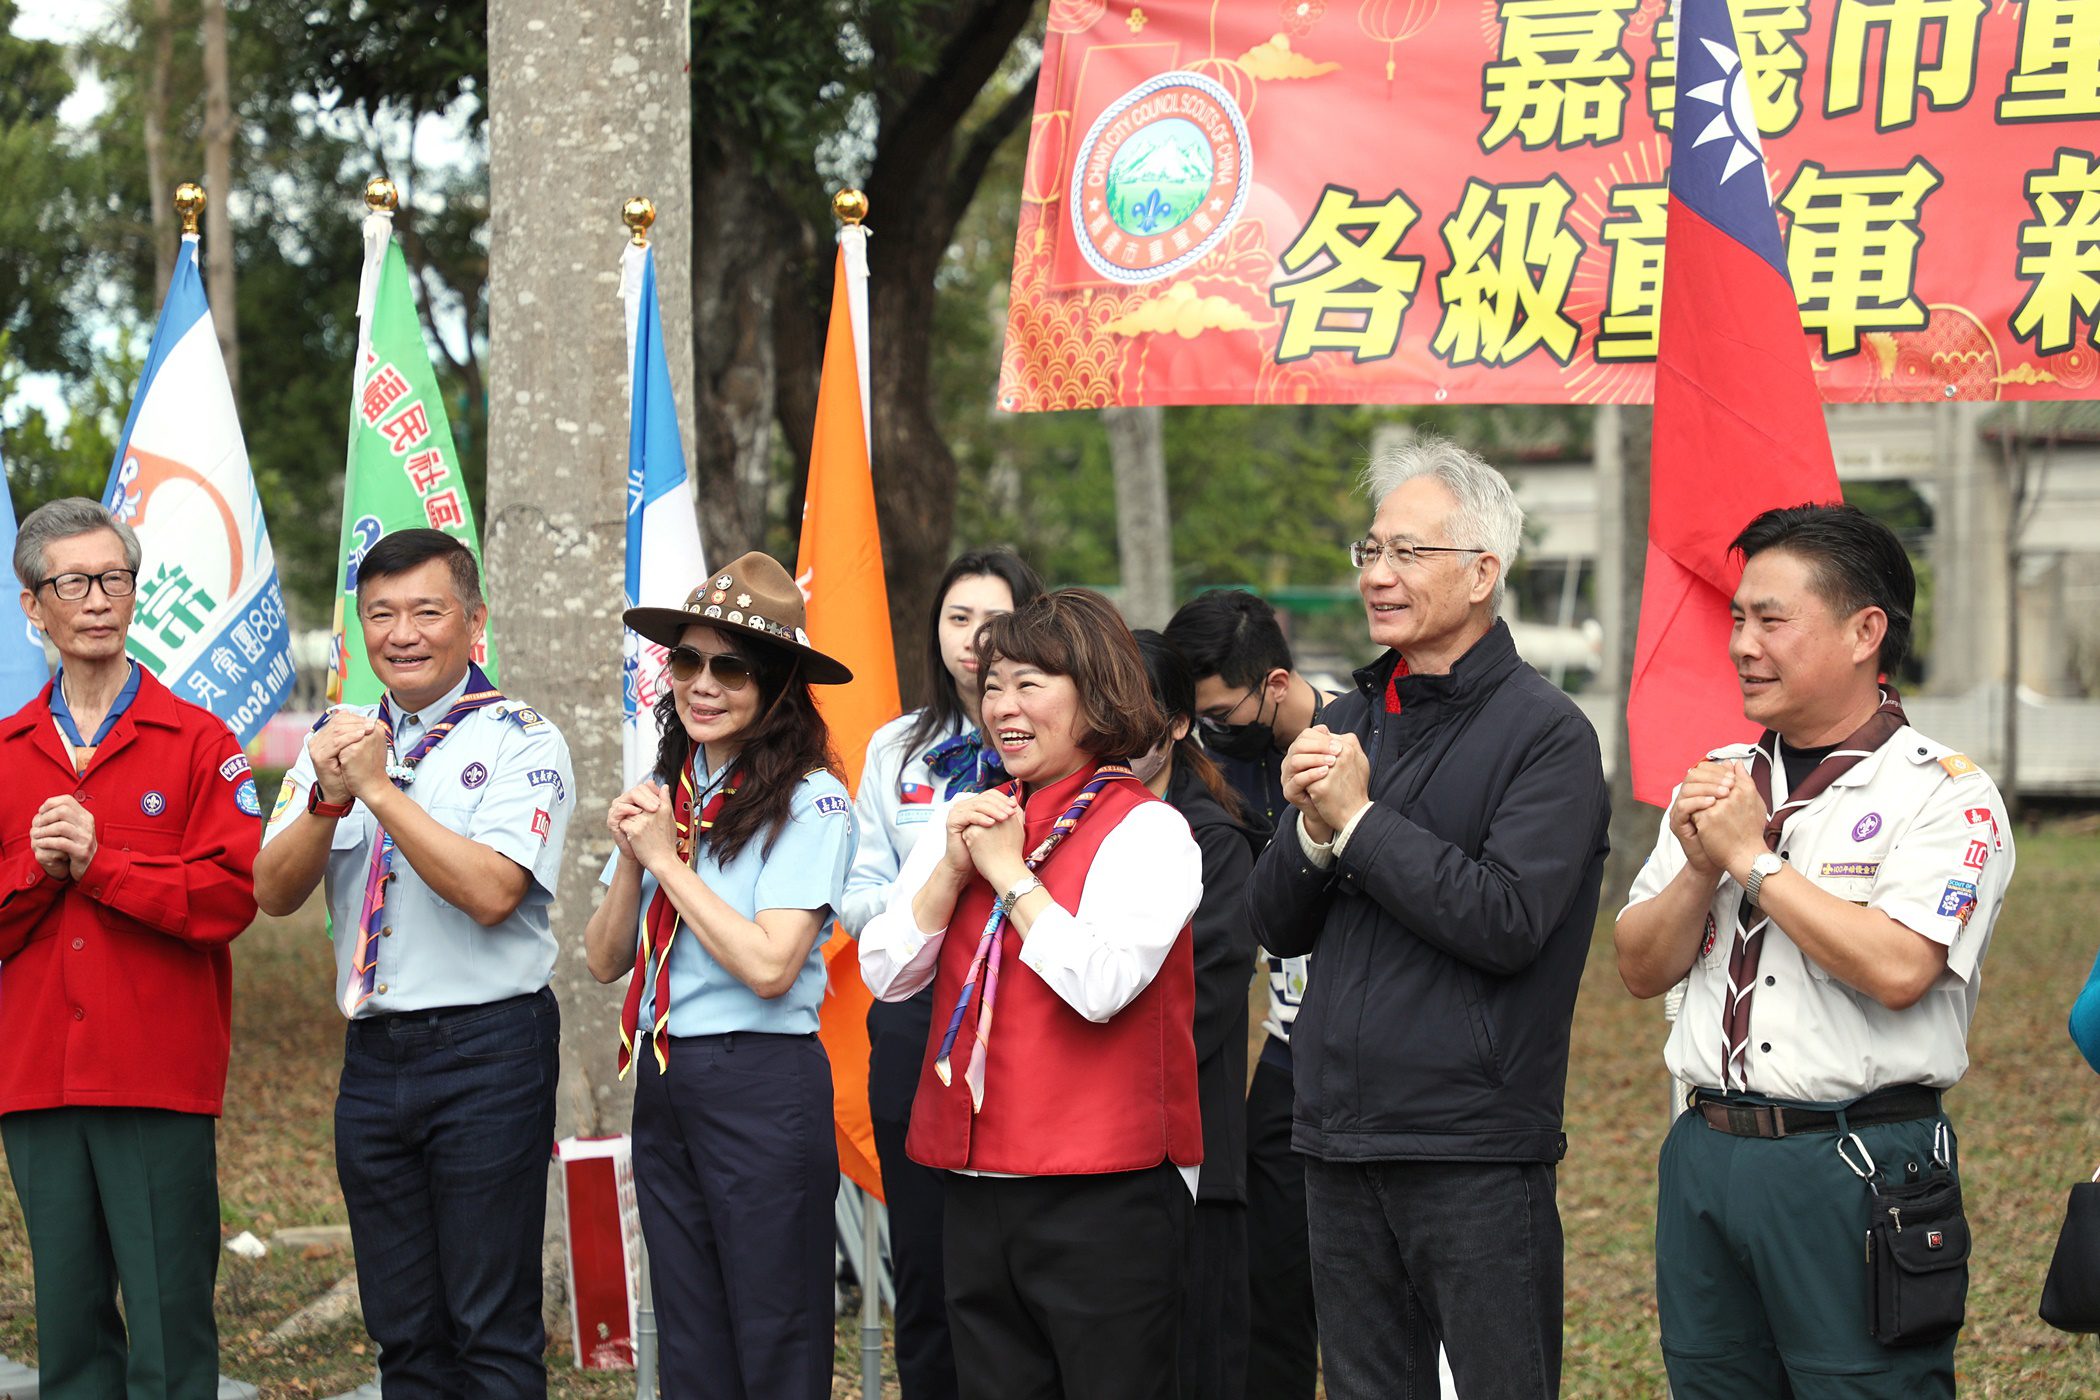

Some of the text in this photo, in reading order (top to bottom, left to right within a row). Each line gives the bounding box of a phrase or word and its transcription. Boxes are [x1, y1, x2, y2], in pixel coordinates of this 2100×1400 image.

[1106, 116, 1134, 145] CITY
[1131, 92, 1180, 125] COUNCIL
[362, 354, 464, 530] 福民社區
